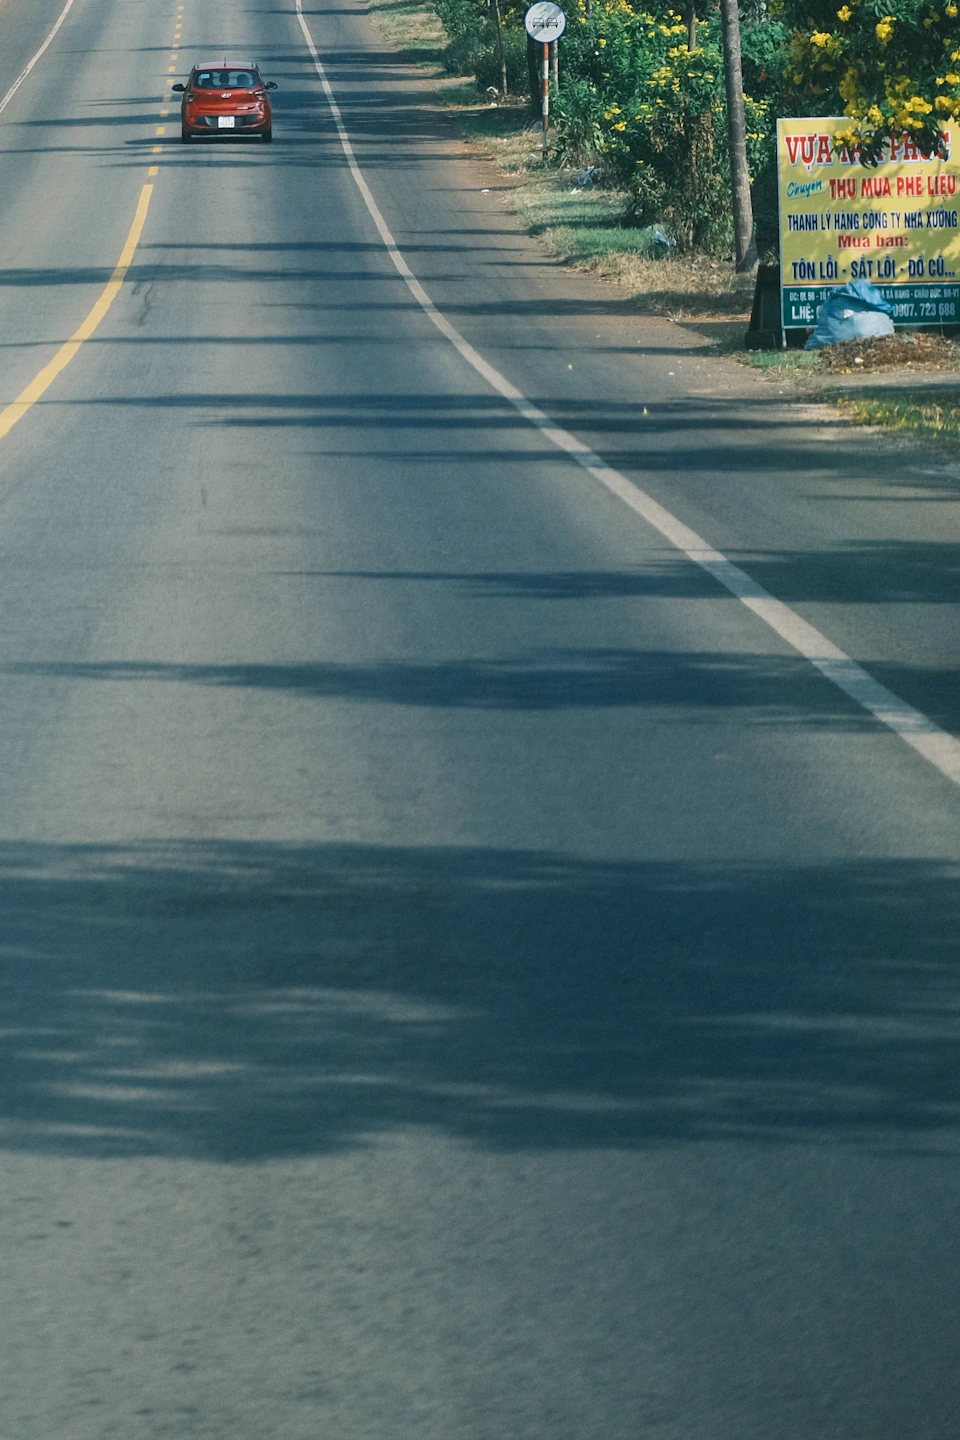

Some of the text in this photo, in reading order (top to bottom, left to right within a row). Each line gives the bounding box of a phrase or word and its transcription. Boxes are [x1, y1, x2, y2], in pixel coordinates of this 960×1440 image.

[785, 133, 832, 170] VỰA
[829, 178, 856, 198] THU
[861, 177, 892, 197] MUA
[896, 171, 923, 196] PHẾ
[927, 172, 956, 200] LIỆU
[788, 206, 958, 231] THANH LÝ HÀNG CÔNG TY NHÀ XƯỞNG
[838, 234, 908, 248] Mua bán:
[792, 257, 816, 280] TÔN
[851, 254, 873, 279] SẮT
[908, 253, 924, 278] ĐỒ
[919, 303, 937, 317] 723
[939, 303, 955, 316] 688
